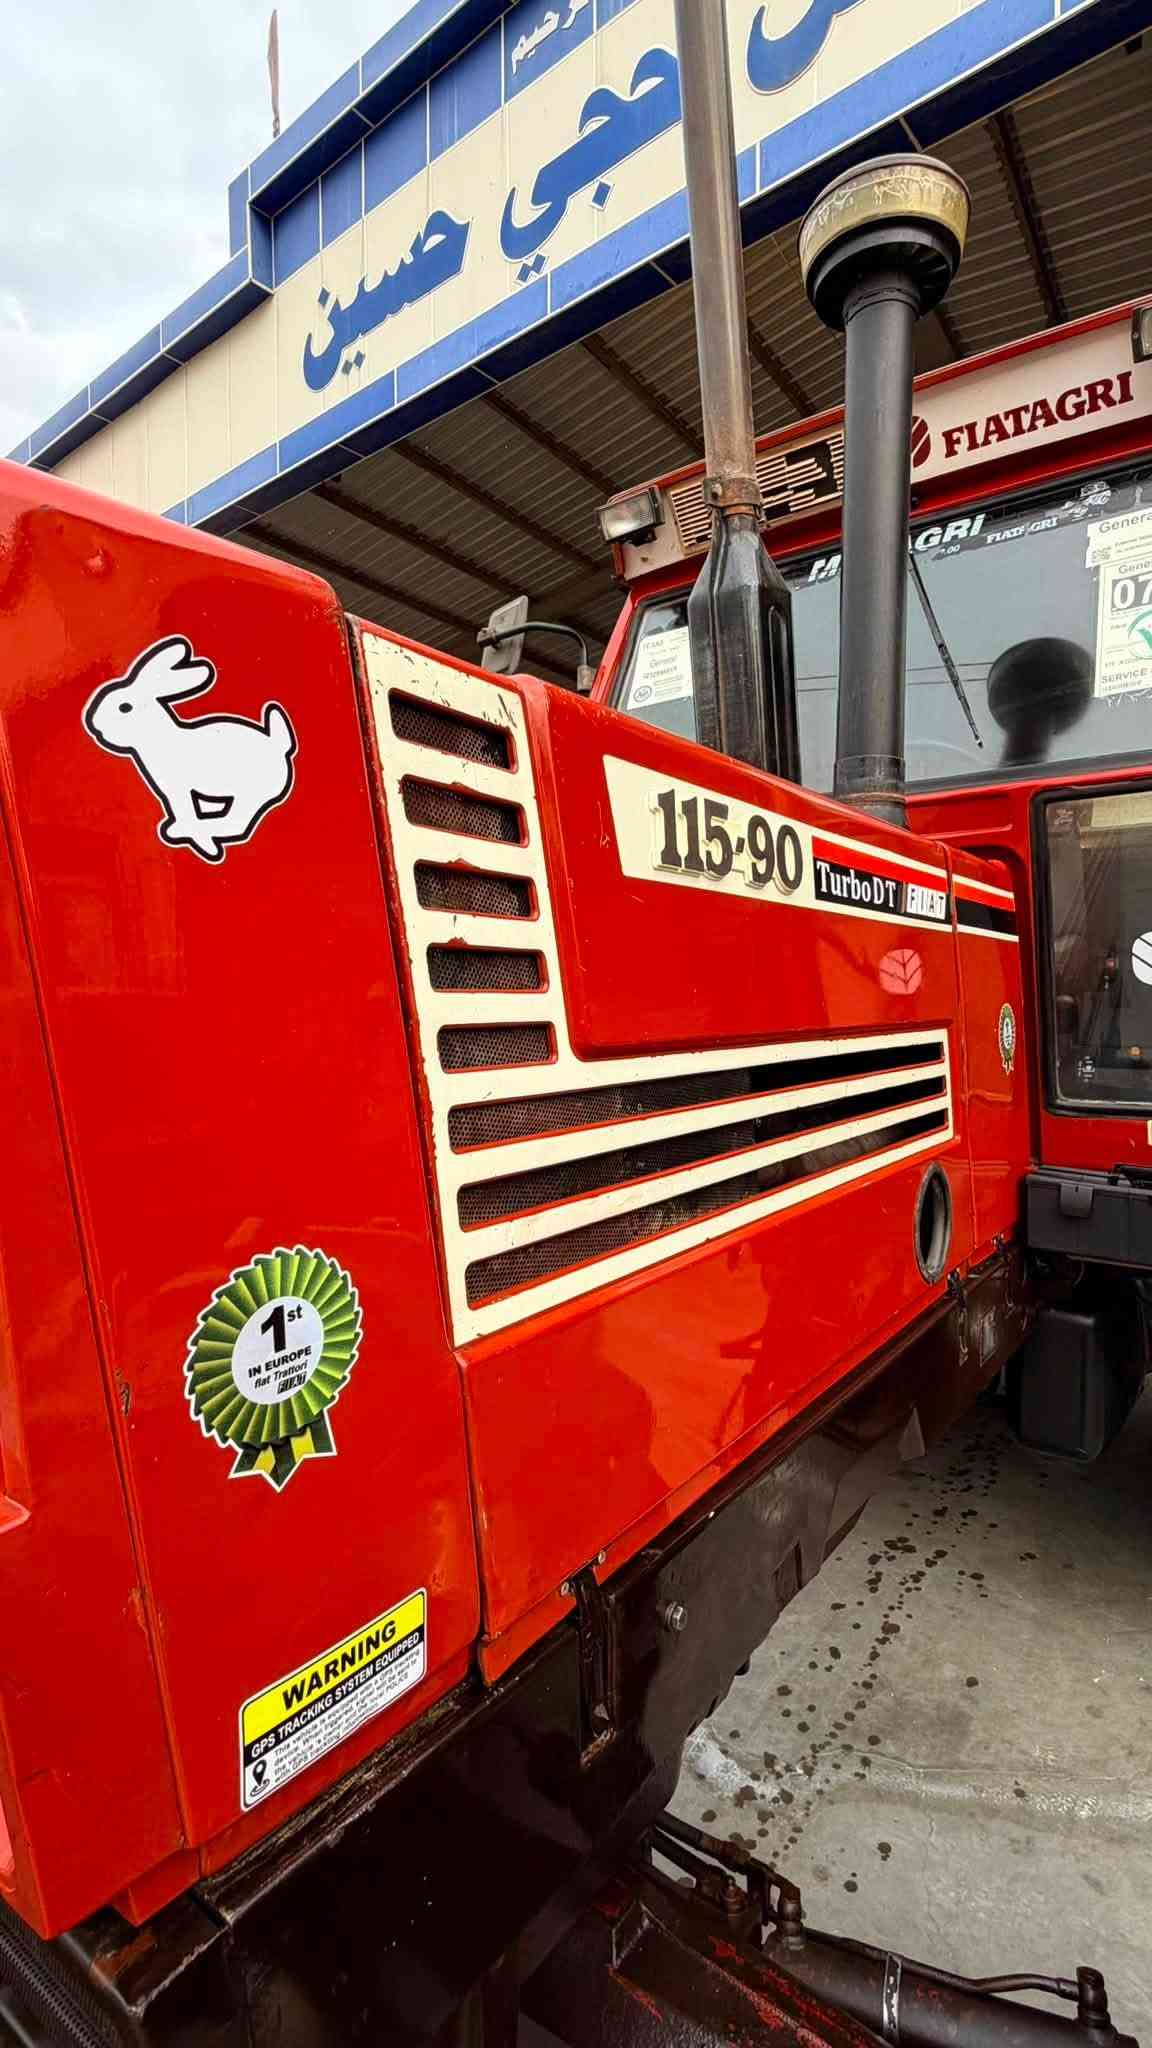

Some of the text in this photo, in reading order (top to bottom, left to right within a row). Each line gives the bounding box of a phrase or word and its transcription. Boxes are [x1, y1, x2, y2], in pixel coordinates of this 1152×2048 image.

[302, 209, 476, 392] حسين
[942, 371, 1134, 459] FIATAGRI
[652, 788, 803, 893] 115-90
[907, 883, 946, 920] FIAT
[248, 1345, 312, 1378] IN EUROPE
[261, 1303, 302, 1353] 1st
[251, 1734, 276, 1758] GPS
[335, 1663, 374, 1702] SYSTEM
[375, 1632, 419, 1670] EQUIPPED
[282, 1620, 396, 1711] WARNING
